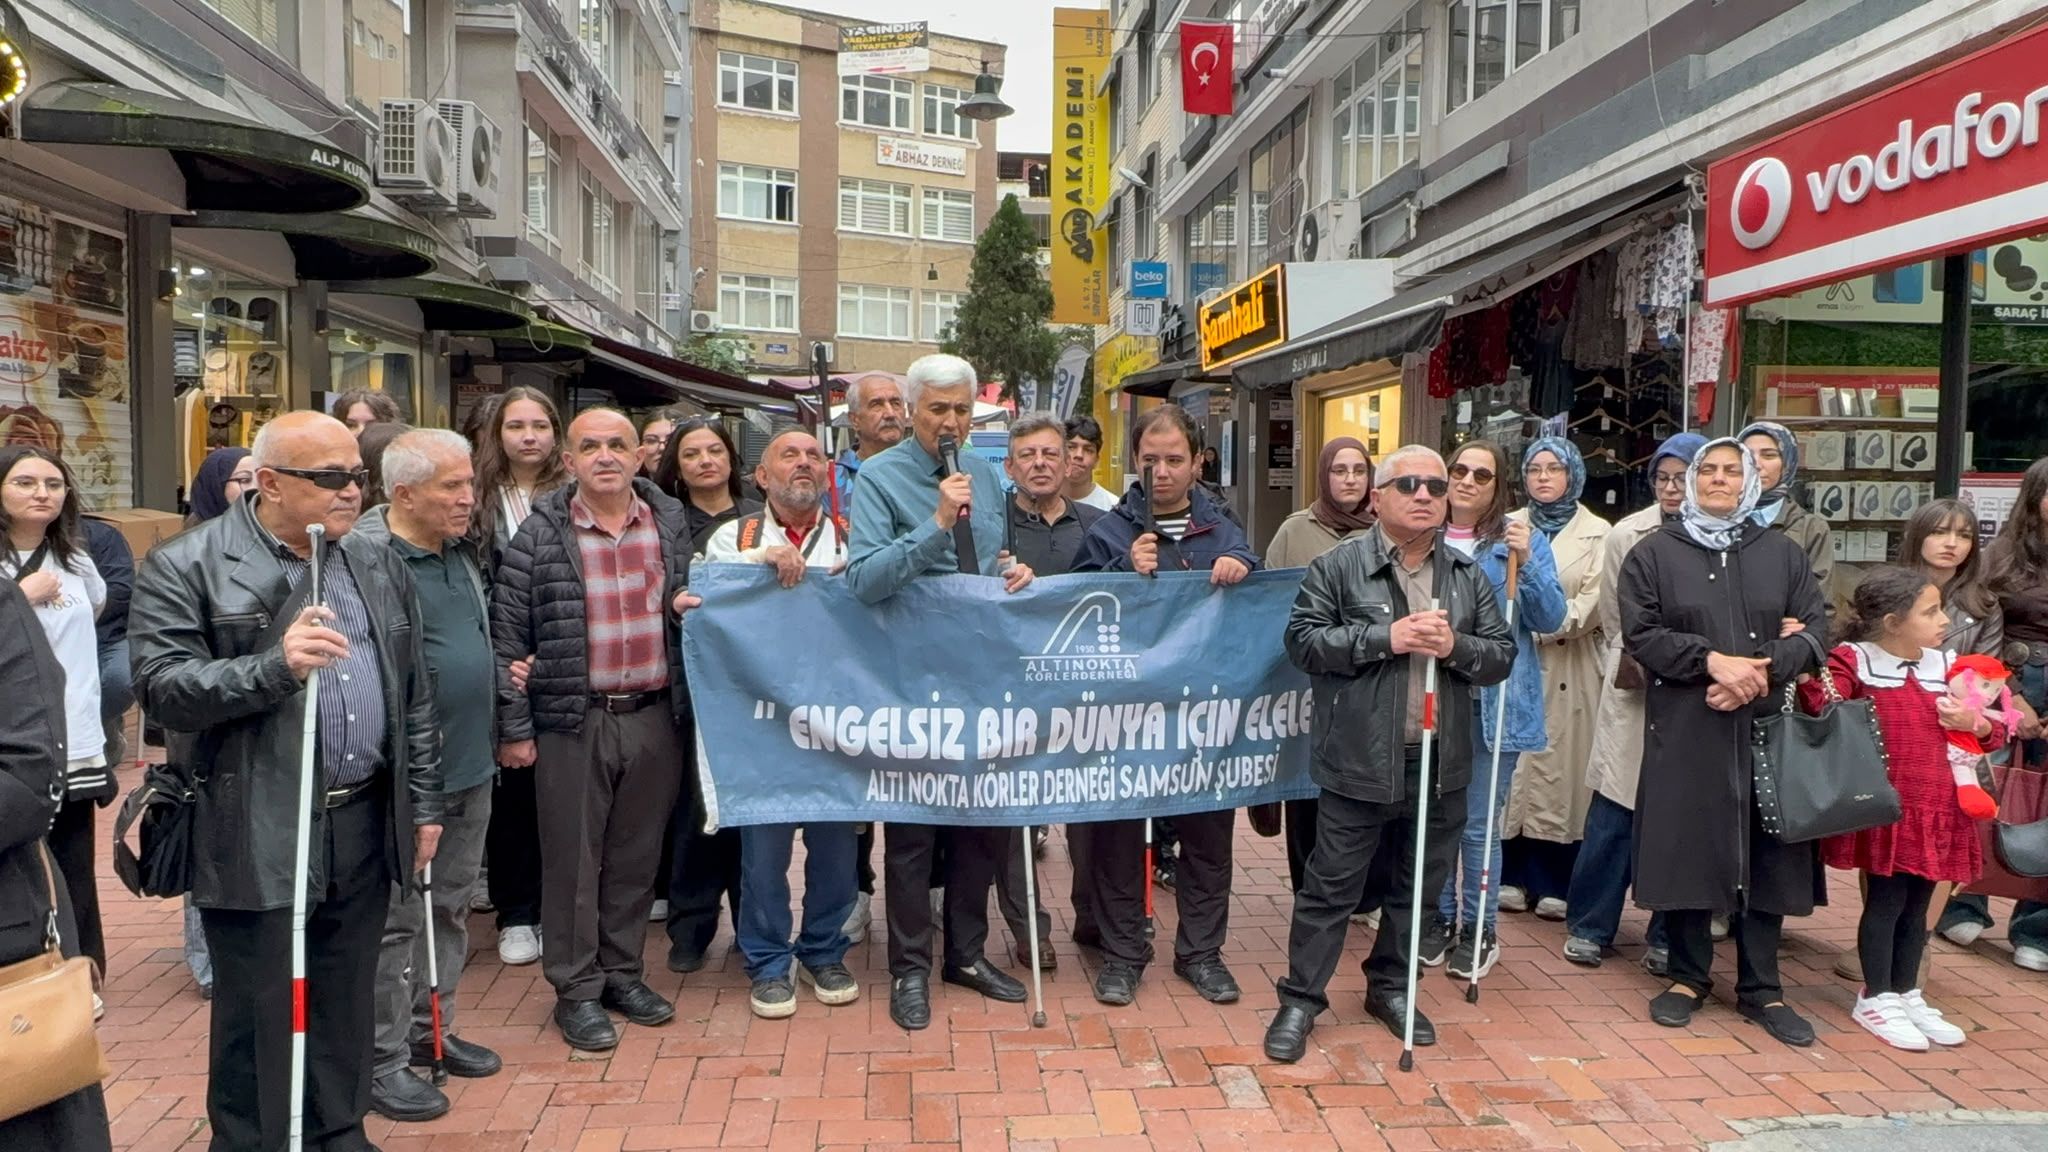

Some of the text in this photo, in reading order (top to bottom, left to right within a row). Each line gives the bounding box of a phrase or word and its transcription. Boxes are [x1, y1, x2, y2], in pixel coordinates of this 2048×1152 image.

[310, 148, 340, 168] ALP
[896, 150, 930, 167] ABHAZ
[1134, 271, 1164, 281] beko
[1994, 306, 2038, 321] SARAÇ
[1075, 644, 1095, 654] 1950
[1026, 658, 1136, 672] ALTINOKTA
[789, 691, 965, 761] ENGELSİZ
[977, 691, 1039, 761] BİR
[1047, 691, 1167, 754] DÜNYA
[1177, 684, 1241, 761] İÇİN
[866, 744, 1281, 808] ALTI NOKTA KÖRLER DERNEĞİ SAMSUN ŞUBESİ
